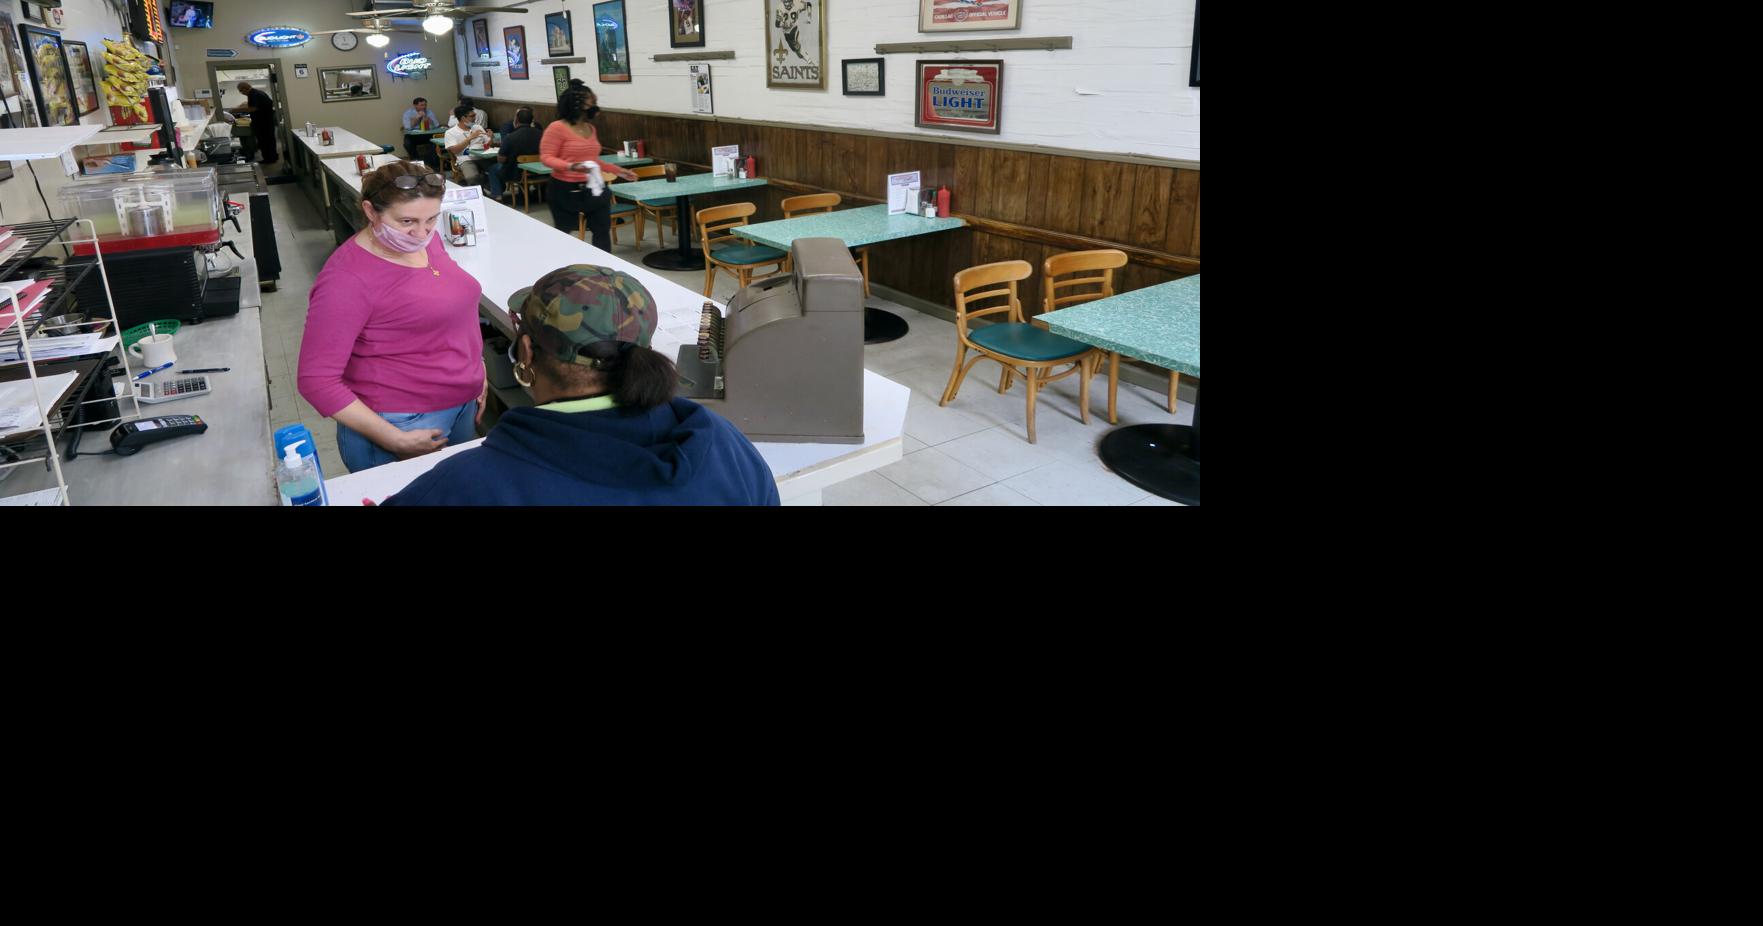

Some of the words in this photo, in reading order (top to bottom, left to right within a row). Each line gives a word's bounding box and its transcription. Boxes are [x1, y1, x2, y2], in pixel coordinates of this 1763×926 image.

[772, 66, 819, 80] SAINTS
[932, 87, 985, 97] Budweiser
[932, 96, 985, 109] LIGHT
